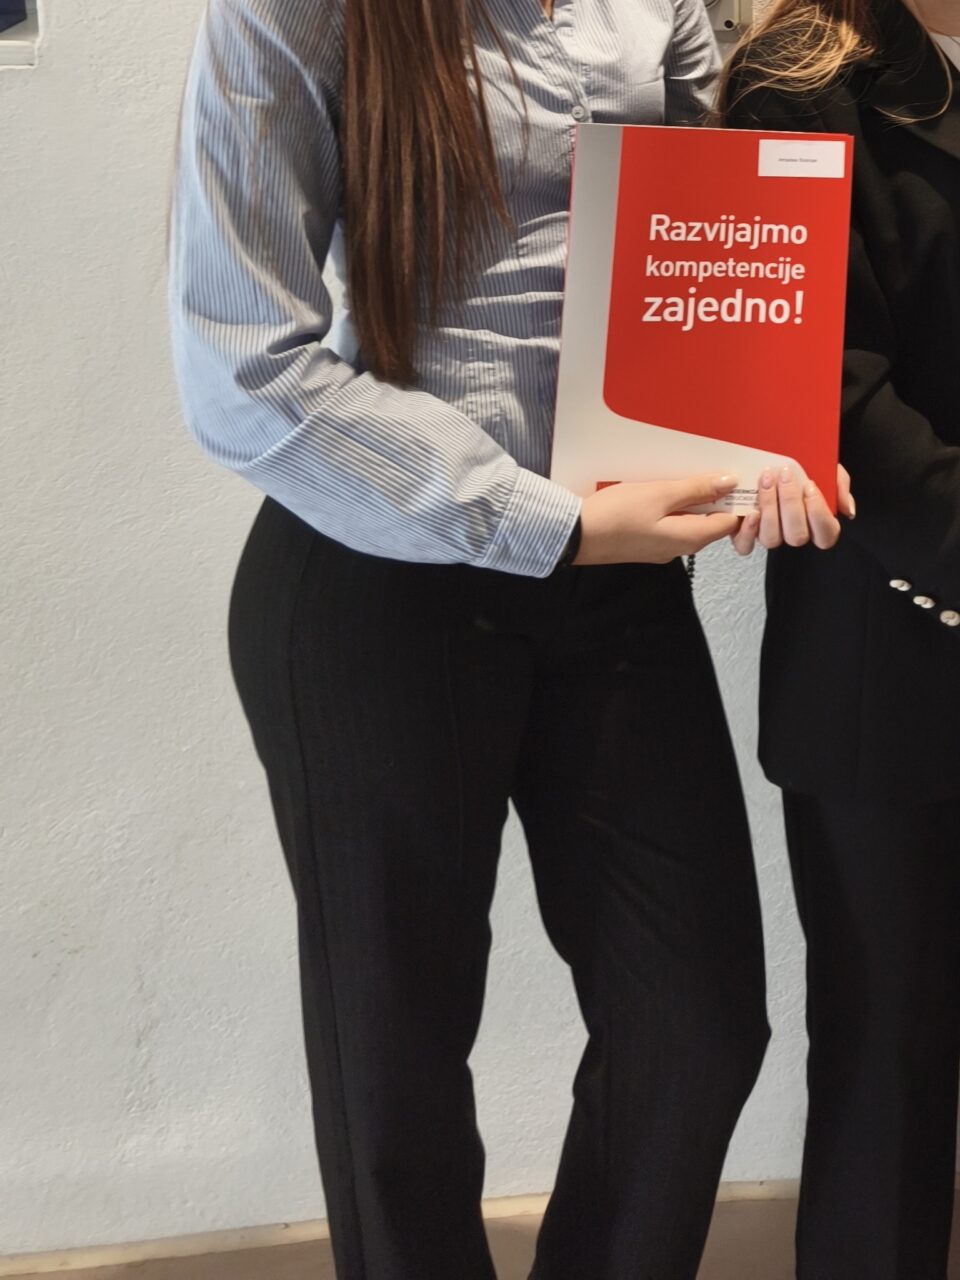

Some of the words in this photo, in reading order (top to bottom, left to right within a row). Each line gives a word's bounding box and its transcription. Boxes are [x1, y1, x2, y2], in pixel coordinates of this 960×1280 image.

[649, 213, 807, 250] Razvijajmo
[645, 254, 805, 284] kompetencije
[642, 286, 804, 331] zajedno!
